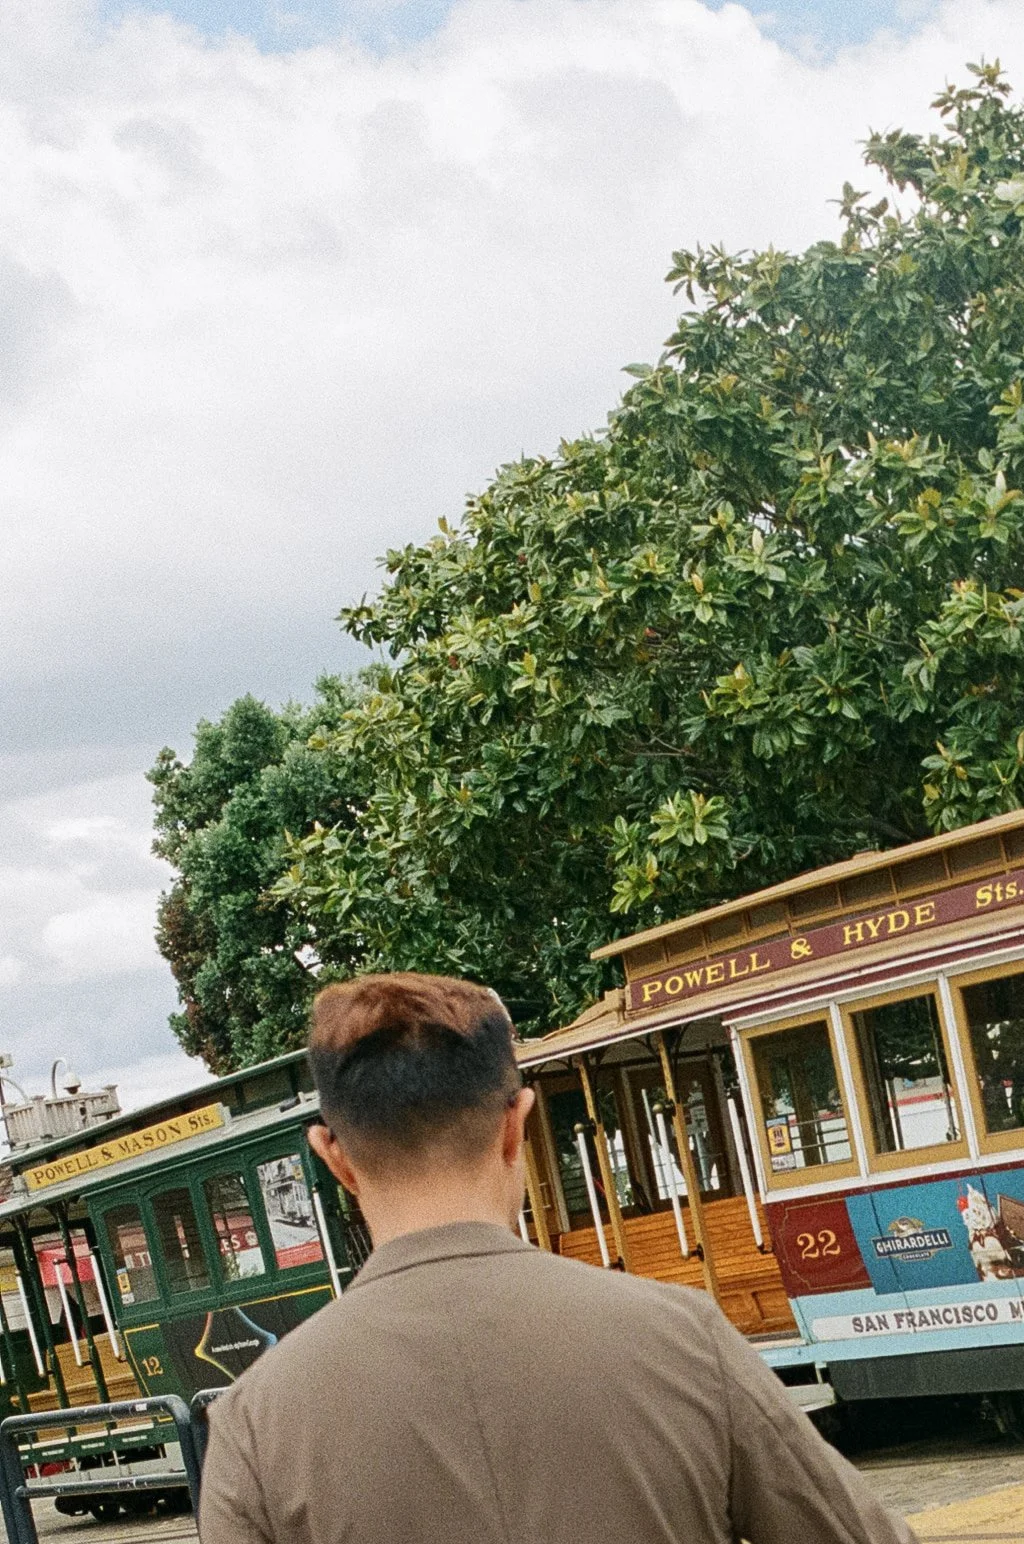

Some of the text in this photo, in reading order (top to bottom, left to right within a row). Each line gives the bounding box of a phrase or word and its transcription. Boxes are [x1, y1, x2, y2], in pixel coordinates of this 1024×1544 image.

[642, 879, 1024, 1002] POWELL & HYDE Sts.
[33, 1113, 214, 1184] POWELL & MASON Sts.
[796, 1229, 841, 1260] 22
[876, 1229, 950, 1254] GHIRARDELLI
[853, 1316, 890, 1333] SAN
[894, 1303, 998, 1330] FRANCISCO
[141, 1356, 164, 1377] 12
